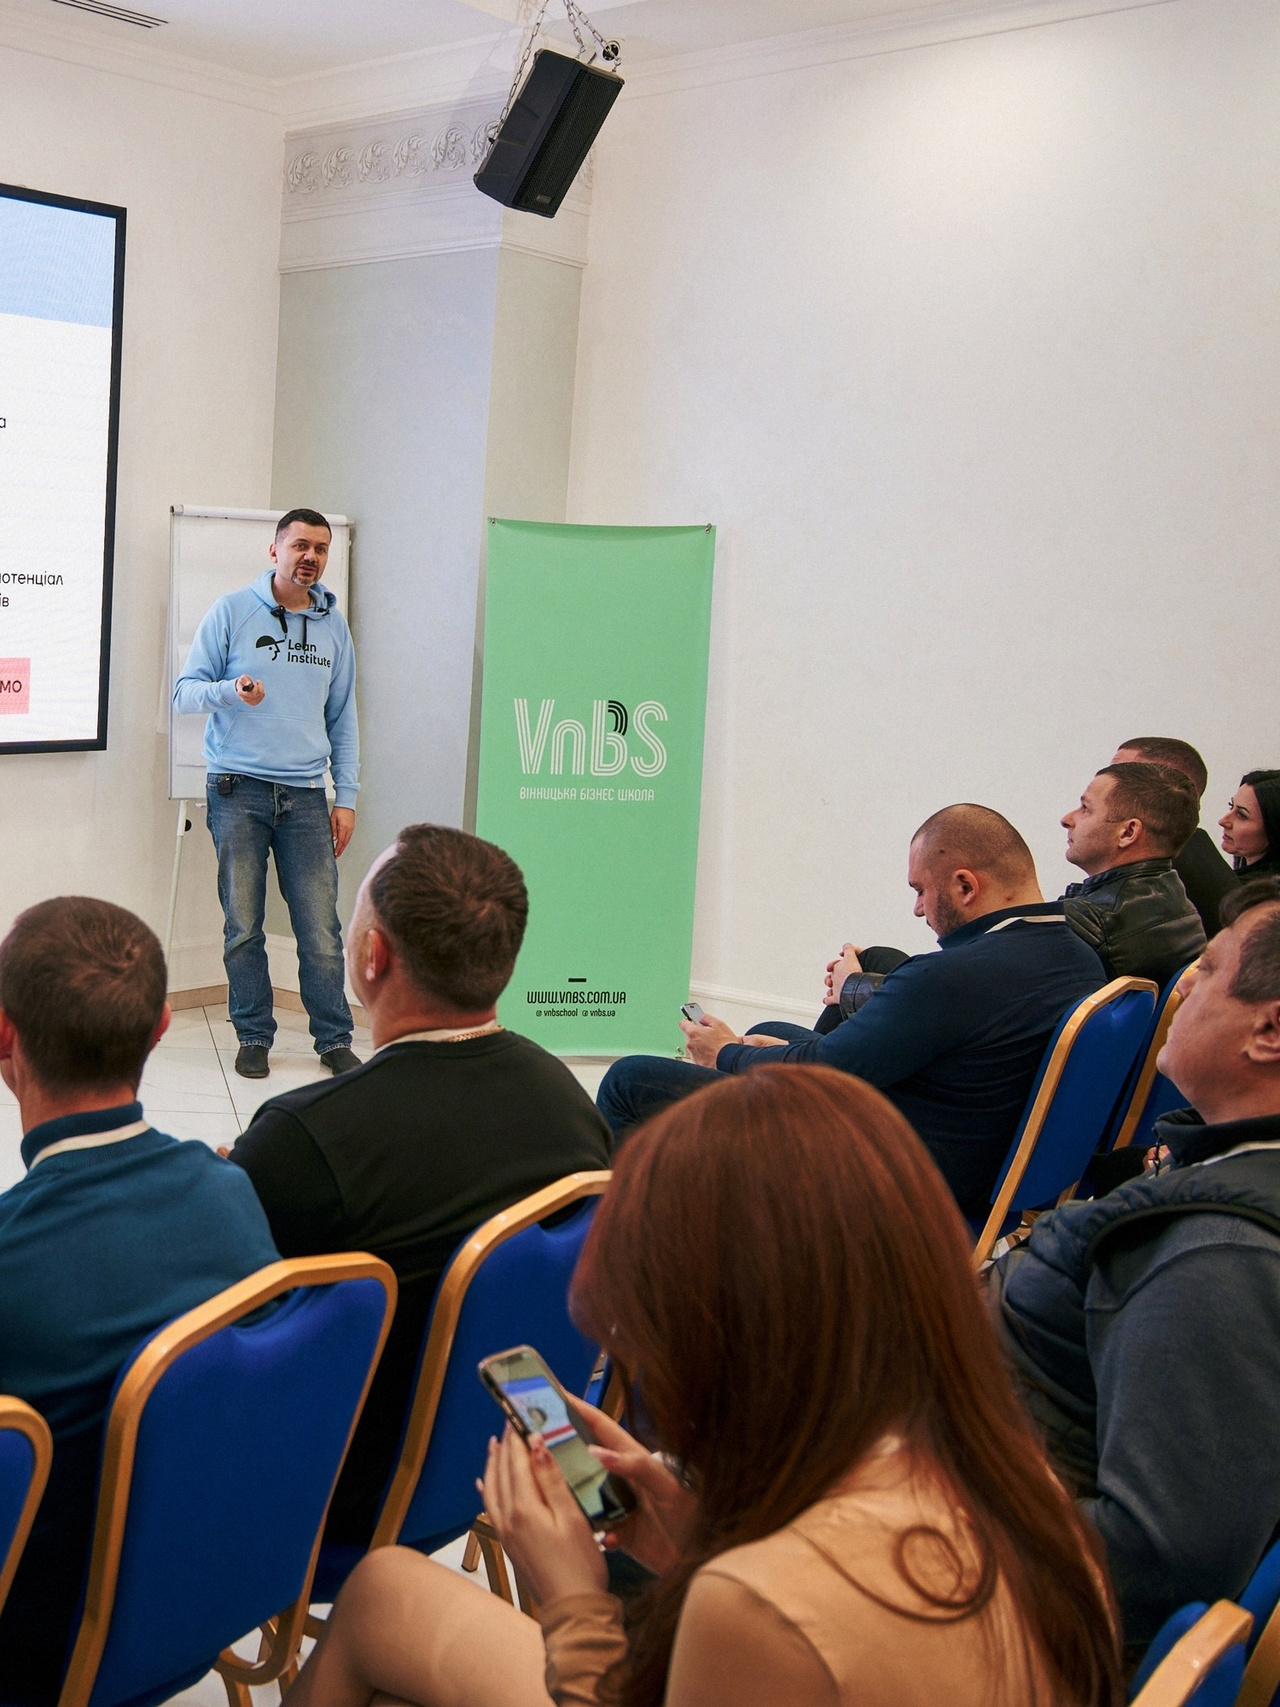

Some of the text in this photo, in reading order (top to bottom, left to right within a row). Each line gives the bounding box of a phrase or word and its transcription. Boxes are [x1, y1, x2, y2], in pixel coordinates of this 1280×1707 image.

[288, 638, 317, 653] Lean
[287, 651, 331, 668] Institute
[513, 698, 668, 778] VnBS
[519, 786, 655, 802] ВІННИЦЬКА БІЗНЕС ШКОЛА
[543, 1008, 616, 1017] vnbschool vnbs.ua
